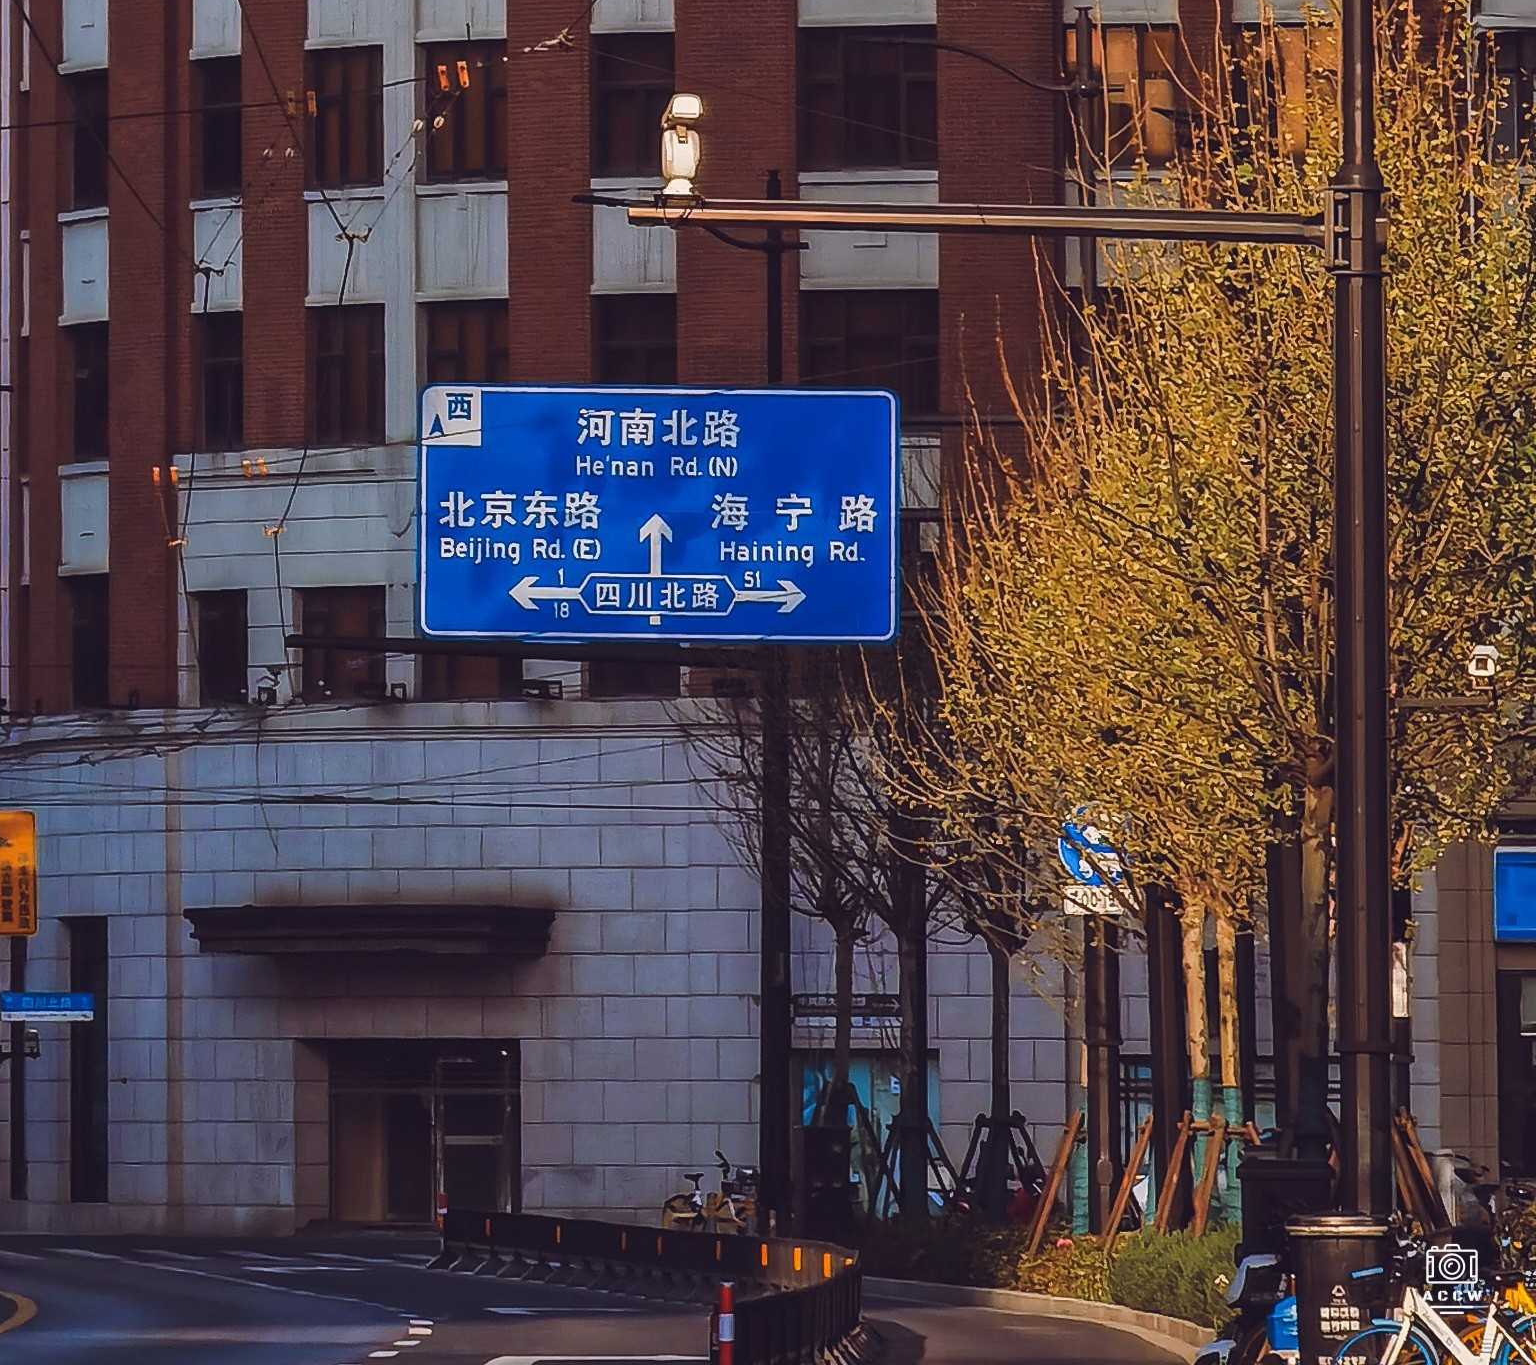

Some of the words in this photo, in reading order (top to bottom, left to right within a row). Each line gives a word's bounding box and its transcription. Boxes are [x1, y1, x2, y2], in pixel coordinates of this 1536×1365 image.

[445, 393, 474, 421] 西
[576, 408, 741, 448] 河南北路
[576, 455, 654, 477] He'nan
[439, 491, 601, 530] 北京东路
[711, 493, 879, 533] 海宁路
[440, 538, 520, 565] Beijing
[533, 539, 566, 560] Rd.
[573, 540, 602, 562] (E)
[720, 541, 814, 568] Haining
[830, 542, 866, 563] Rd.
[596, 581, 720, 610] 四川北路
[553, 601, 570, 619] 18
